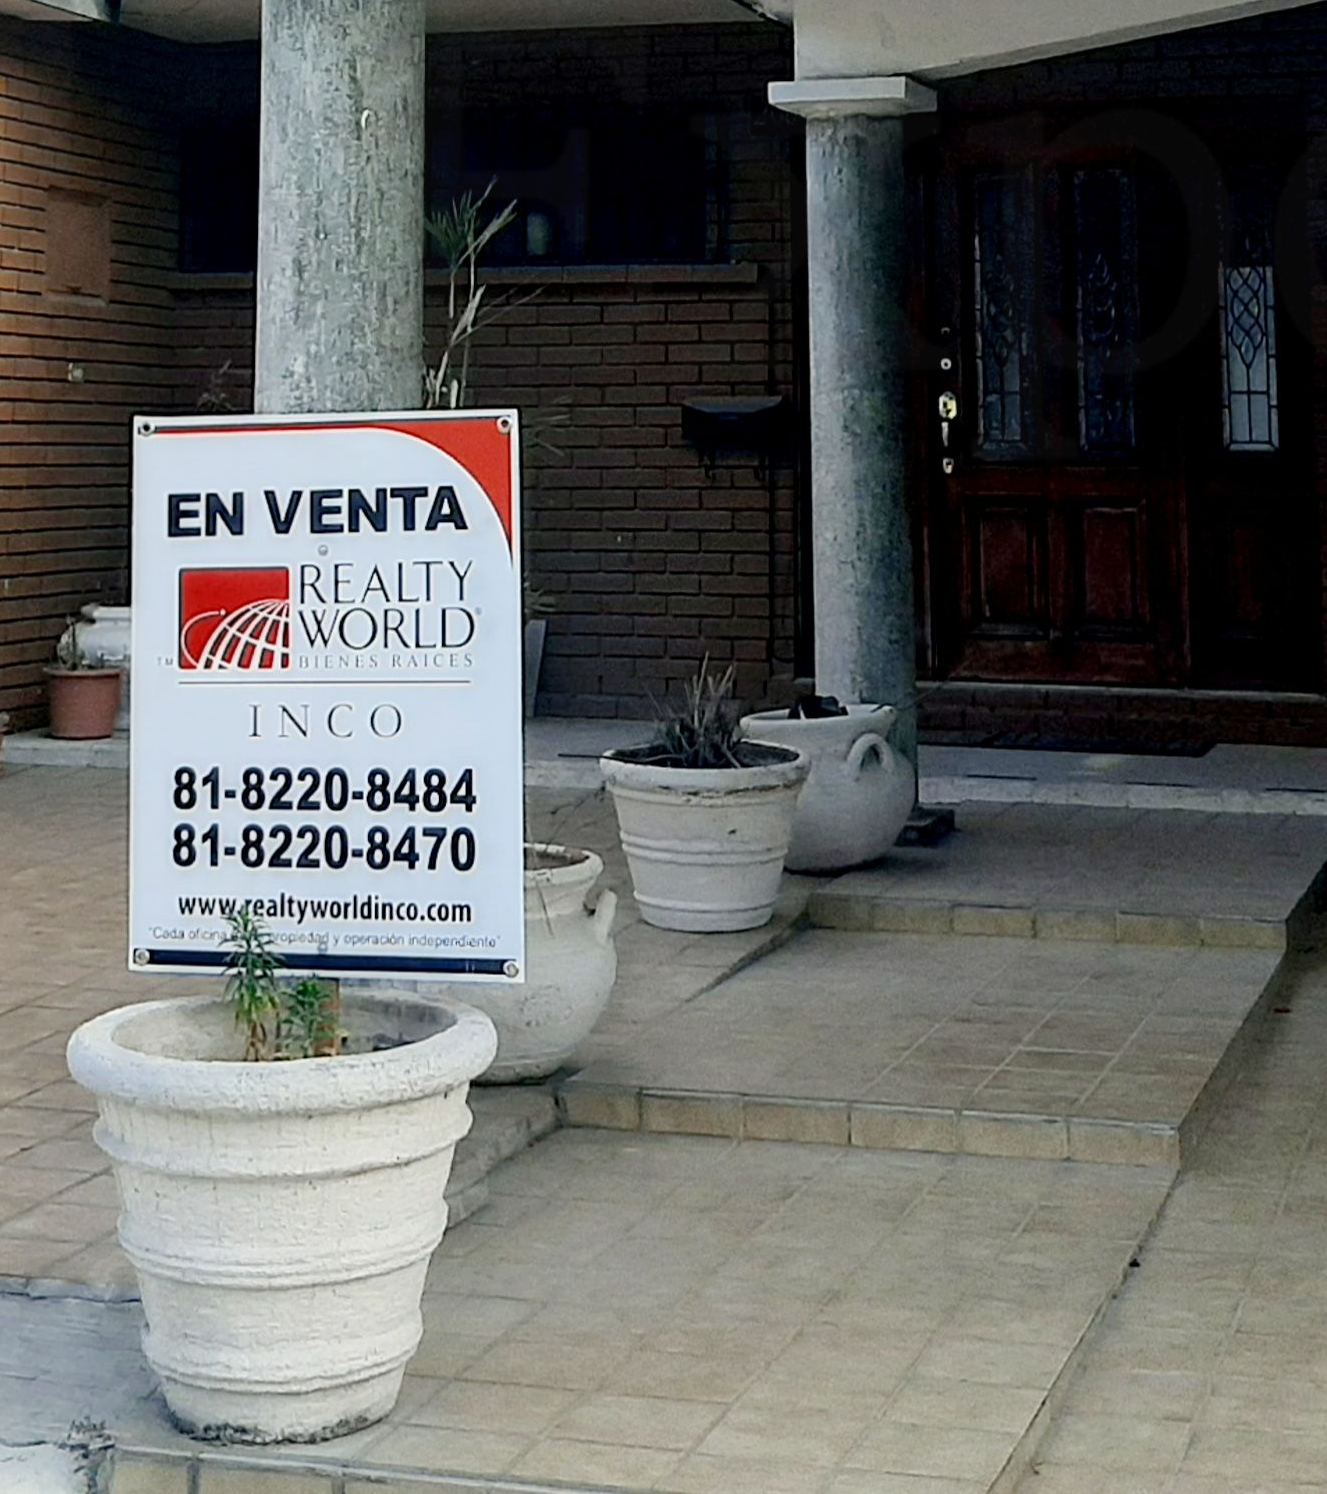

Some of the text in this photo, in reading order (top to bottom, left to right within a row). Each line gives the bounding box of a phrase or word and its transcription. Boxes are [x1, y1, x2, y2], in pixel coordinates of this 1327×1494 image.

[167, 485, 469, 538] EN VENTA
[299, 560, 474, 604] REALTY
[298, 607, 476, 650] WORLD
[299, 655, 378, 669] BIENES
[248, 704, 402, 738] INCO
[173, 766, 477, 813] 81-8220-8484
[172, 823, 476, 871] 81-8220-8470
[178, 892, 472, 924] www.realtyworldinco.com
